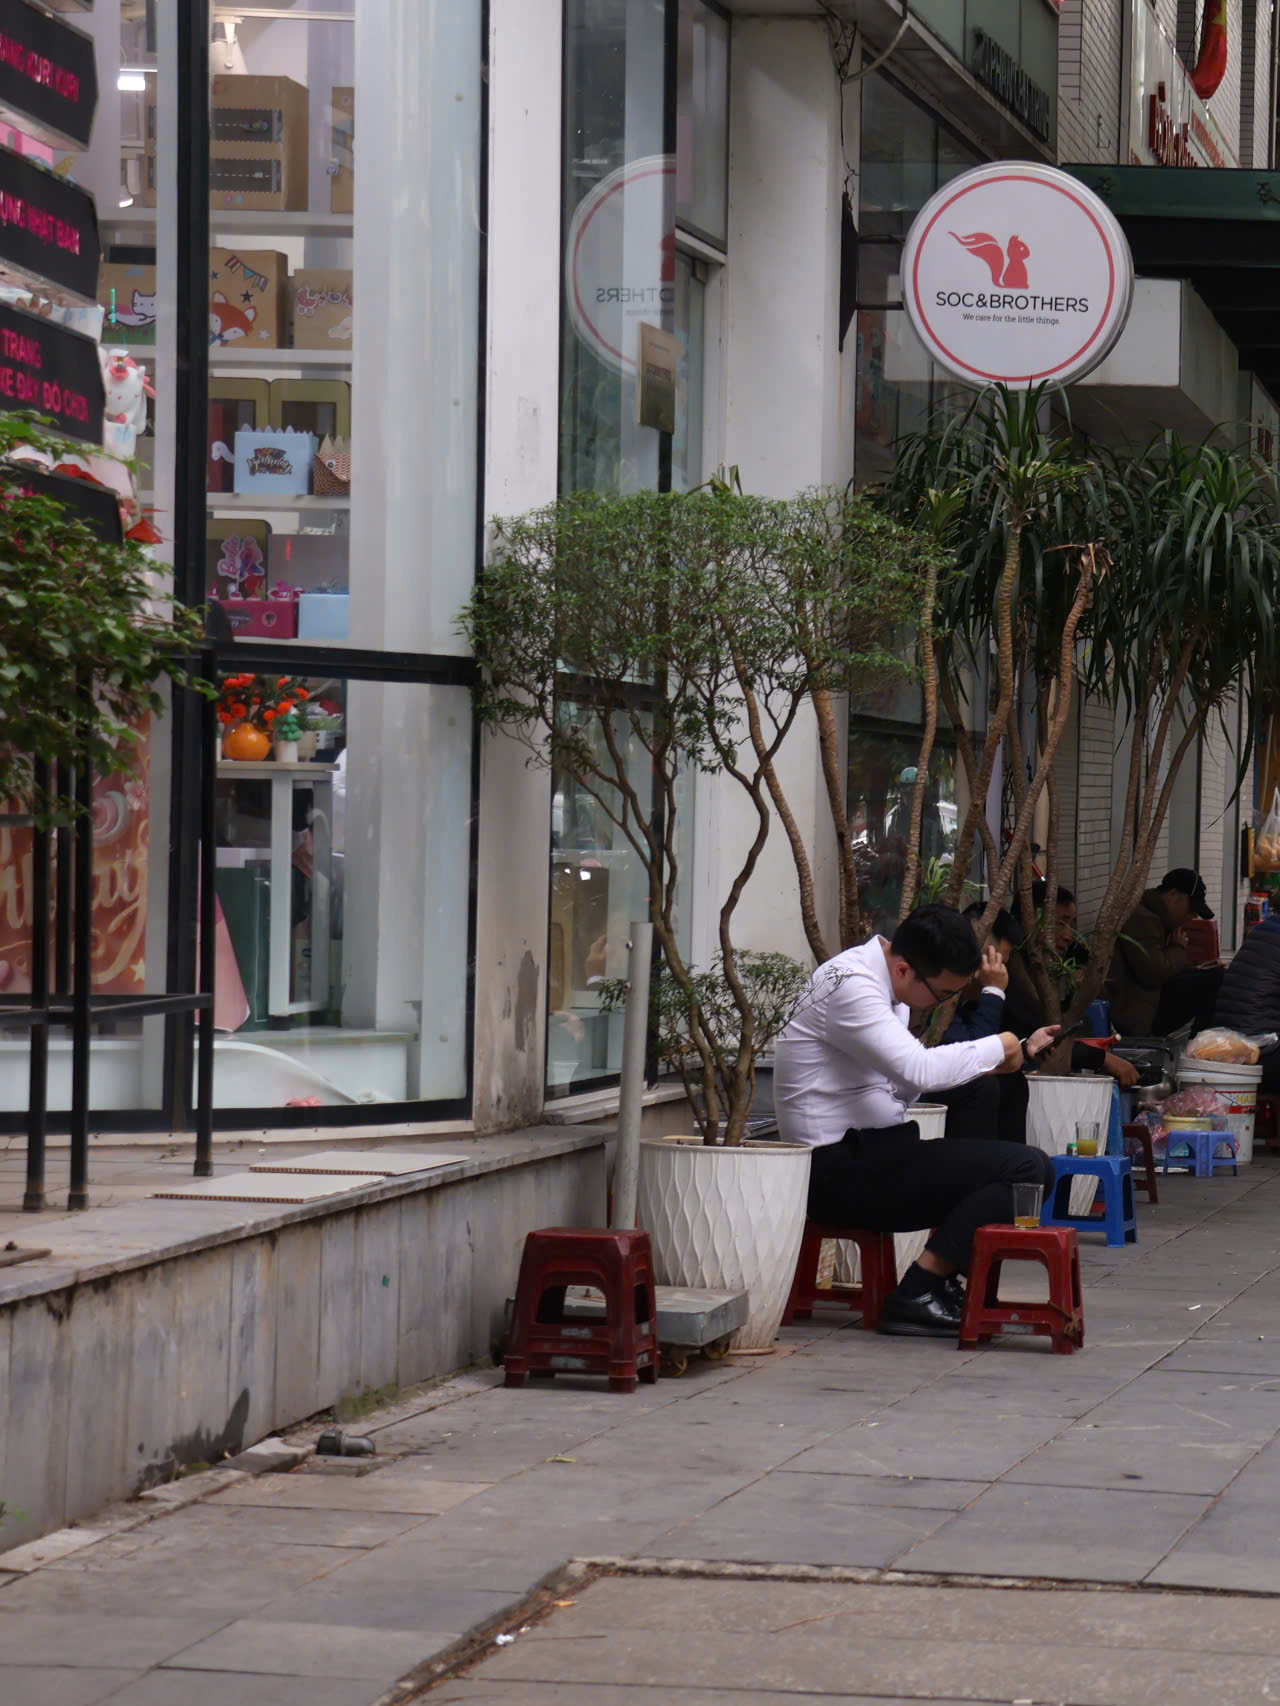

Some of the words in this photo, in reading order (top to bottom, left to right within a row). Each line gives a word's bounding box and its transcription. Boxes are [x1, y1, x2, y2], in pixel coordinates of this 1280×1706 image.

[936, 291, 1089, 313] SOC&BROTHERS
[963, 313, 974, 321] We
[992, 314, 1003, 322] for
[1004, 315, 1017, 323] the
[1018, 315, 1035, 324] little
[1036, 316, 1060, 326] things
